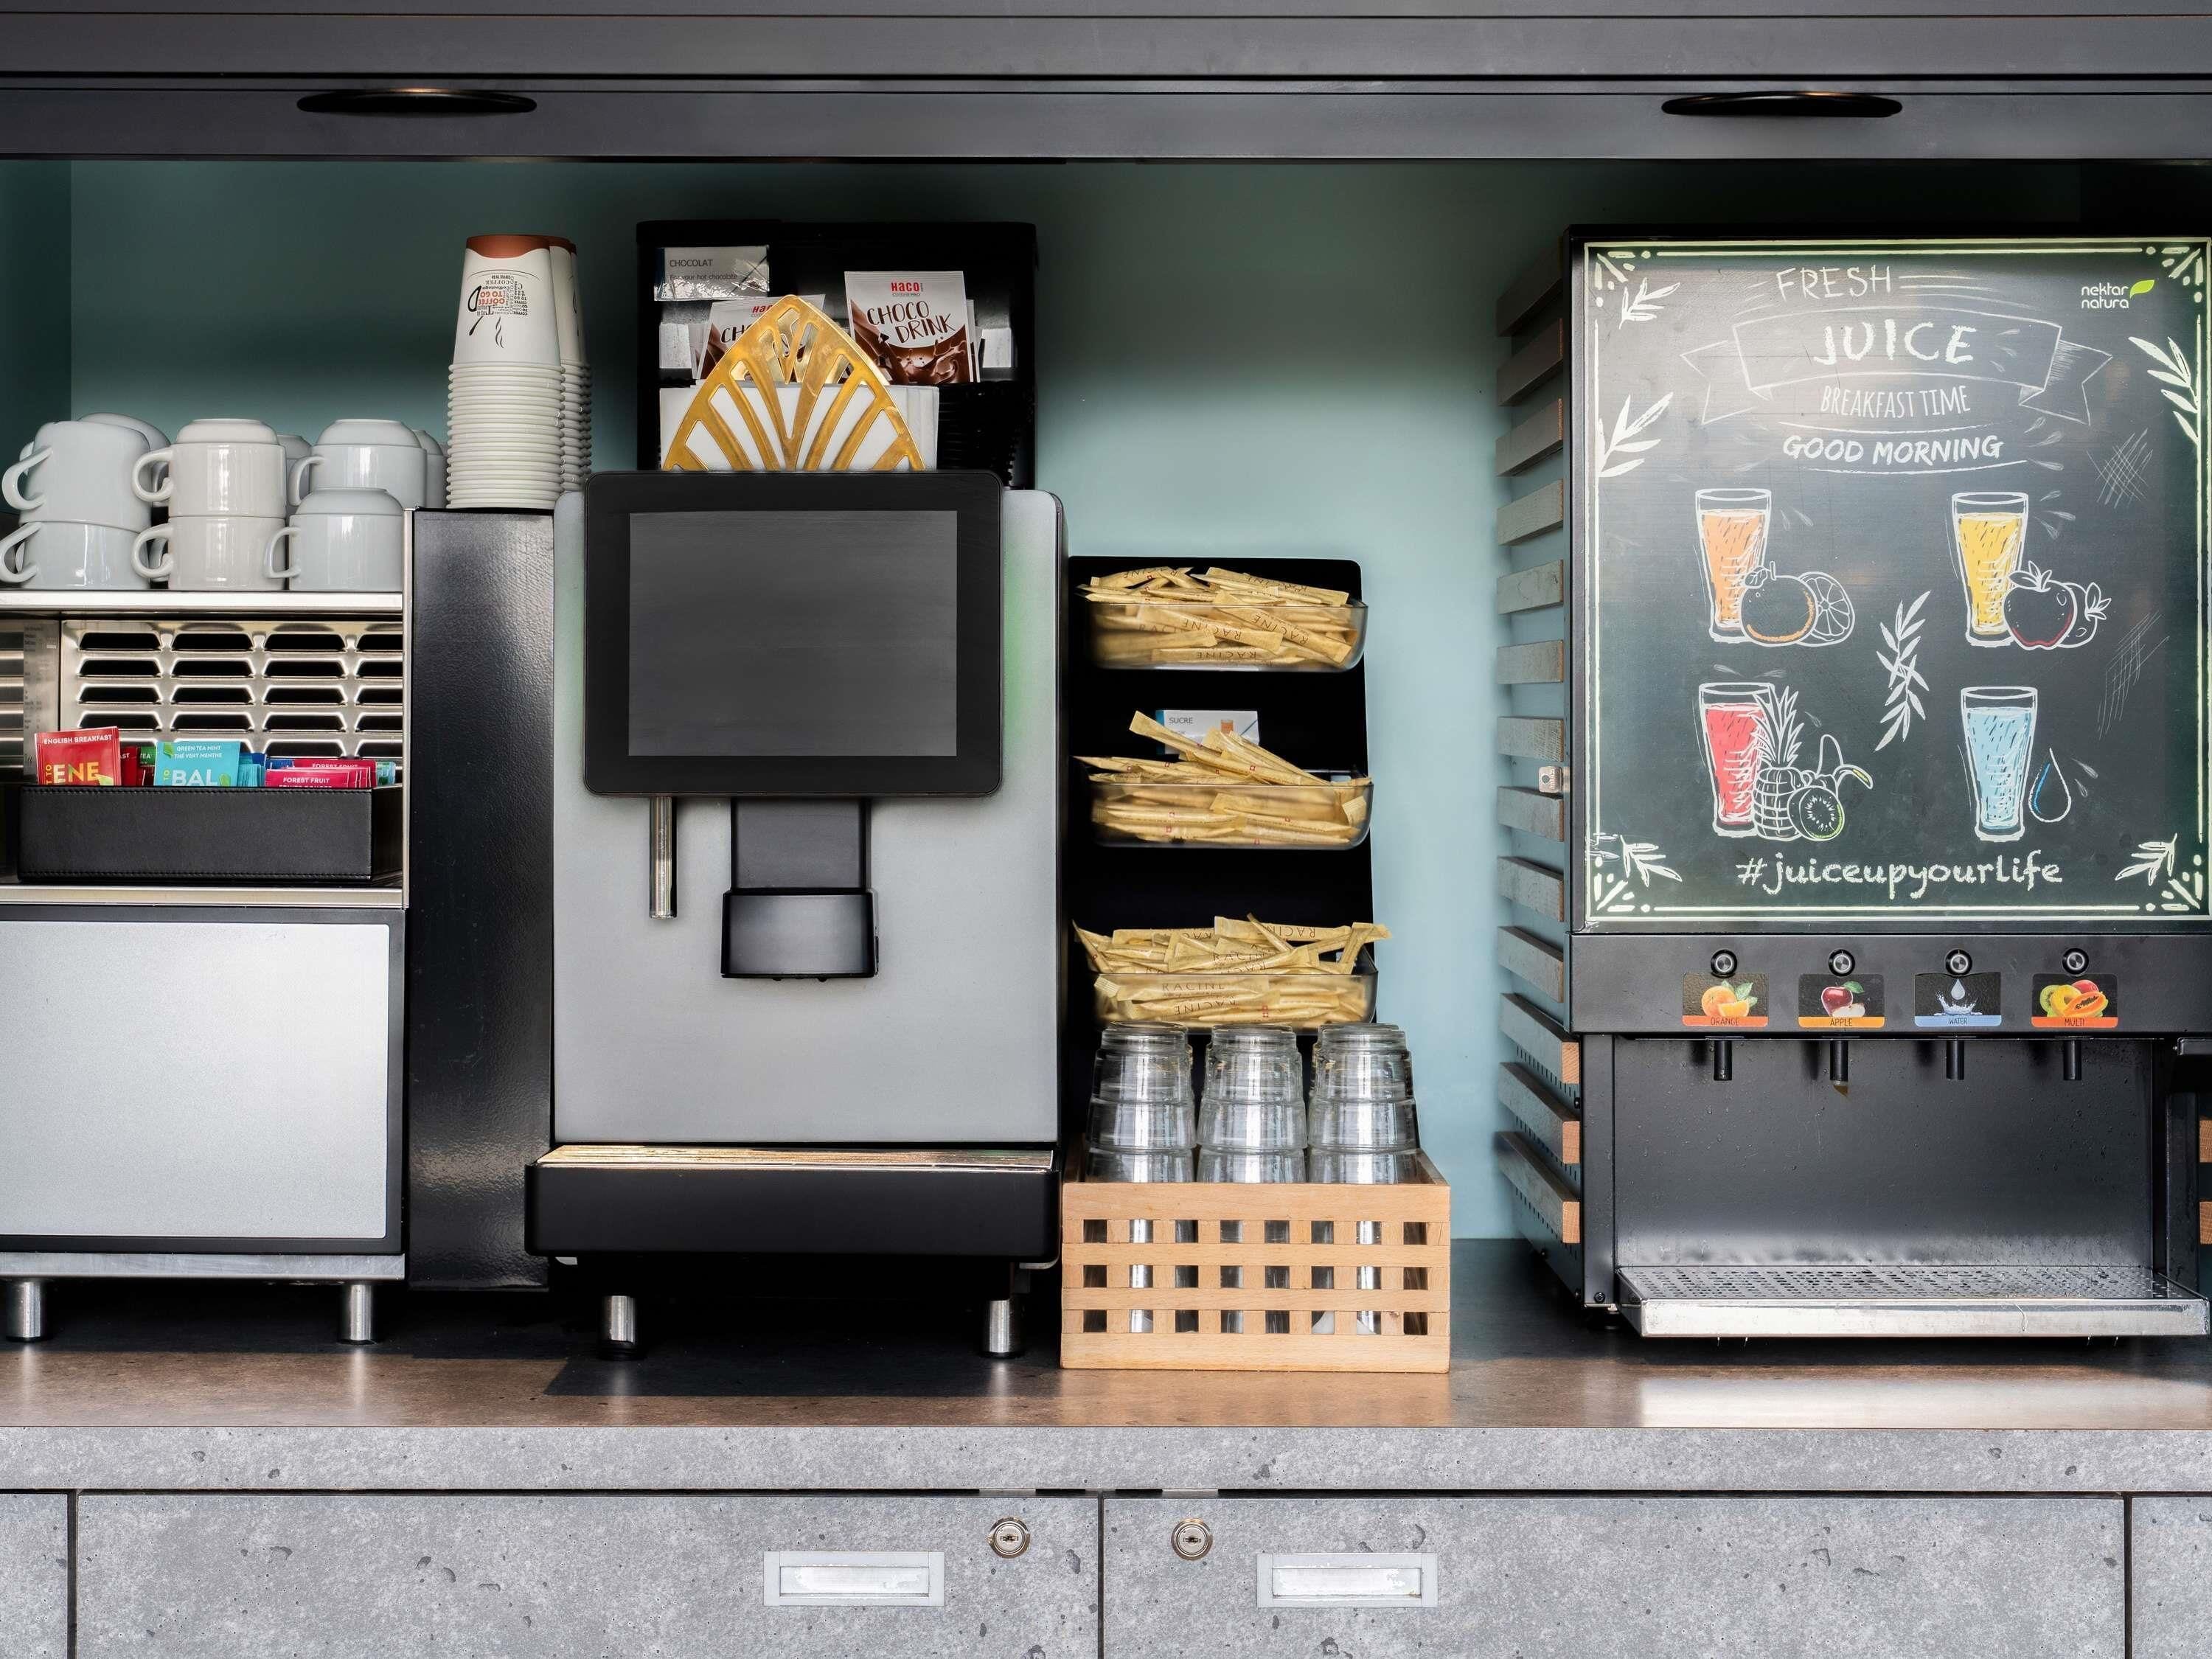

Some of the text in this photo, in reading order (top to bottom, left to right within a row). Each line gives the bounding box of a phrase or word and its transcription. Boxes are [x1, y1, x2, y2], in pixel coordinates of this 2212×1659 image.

[1776, 265, 1891, 302] FRESH
[2081, 282, 2129, 296] nektar
[866, 300, 930, 325] CHOCO
[2081, 296, 2129, 308] natura
[894, 313, 956, 344] DRINK
[1814, 319, 1977, 365] JUICE
[1820, 385, 1971, 418] BREAKFAST TIME
[1783, 434, 2004, 465] GOOD MORNING
[1184, 618, 1242, 640] RACINE
[1251, 615, 1310, 645] RACINE
[74, 734, 113, 743] BREAKFAST
[53, 762, 100, 784] ENE
[172, 769, 218, 786] BAL
[1736, 850, 2063, 900] #juiceupyourlife
[1710, 1018, 1739, 1026] ORANGE
[1830, 1018, 1853, 1026] APPLE
[1949, 1017, 1968, 1025] WATER
[2065, 1018, 2085, 1026] MULTI
